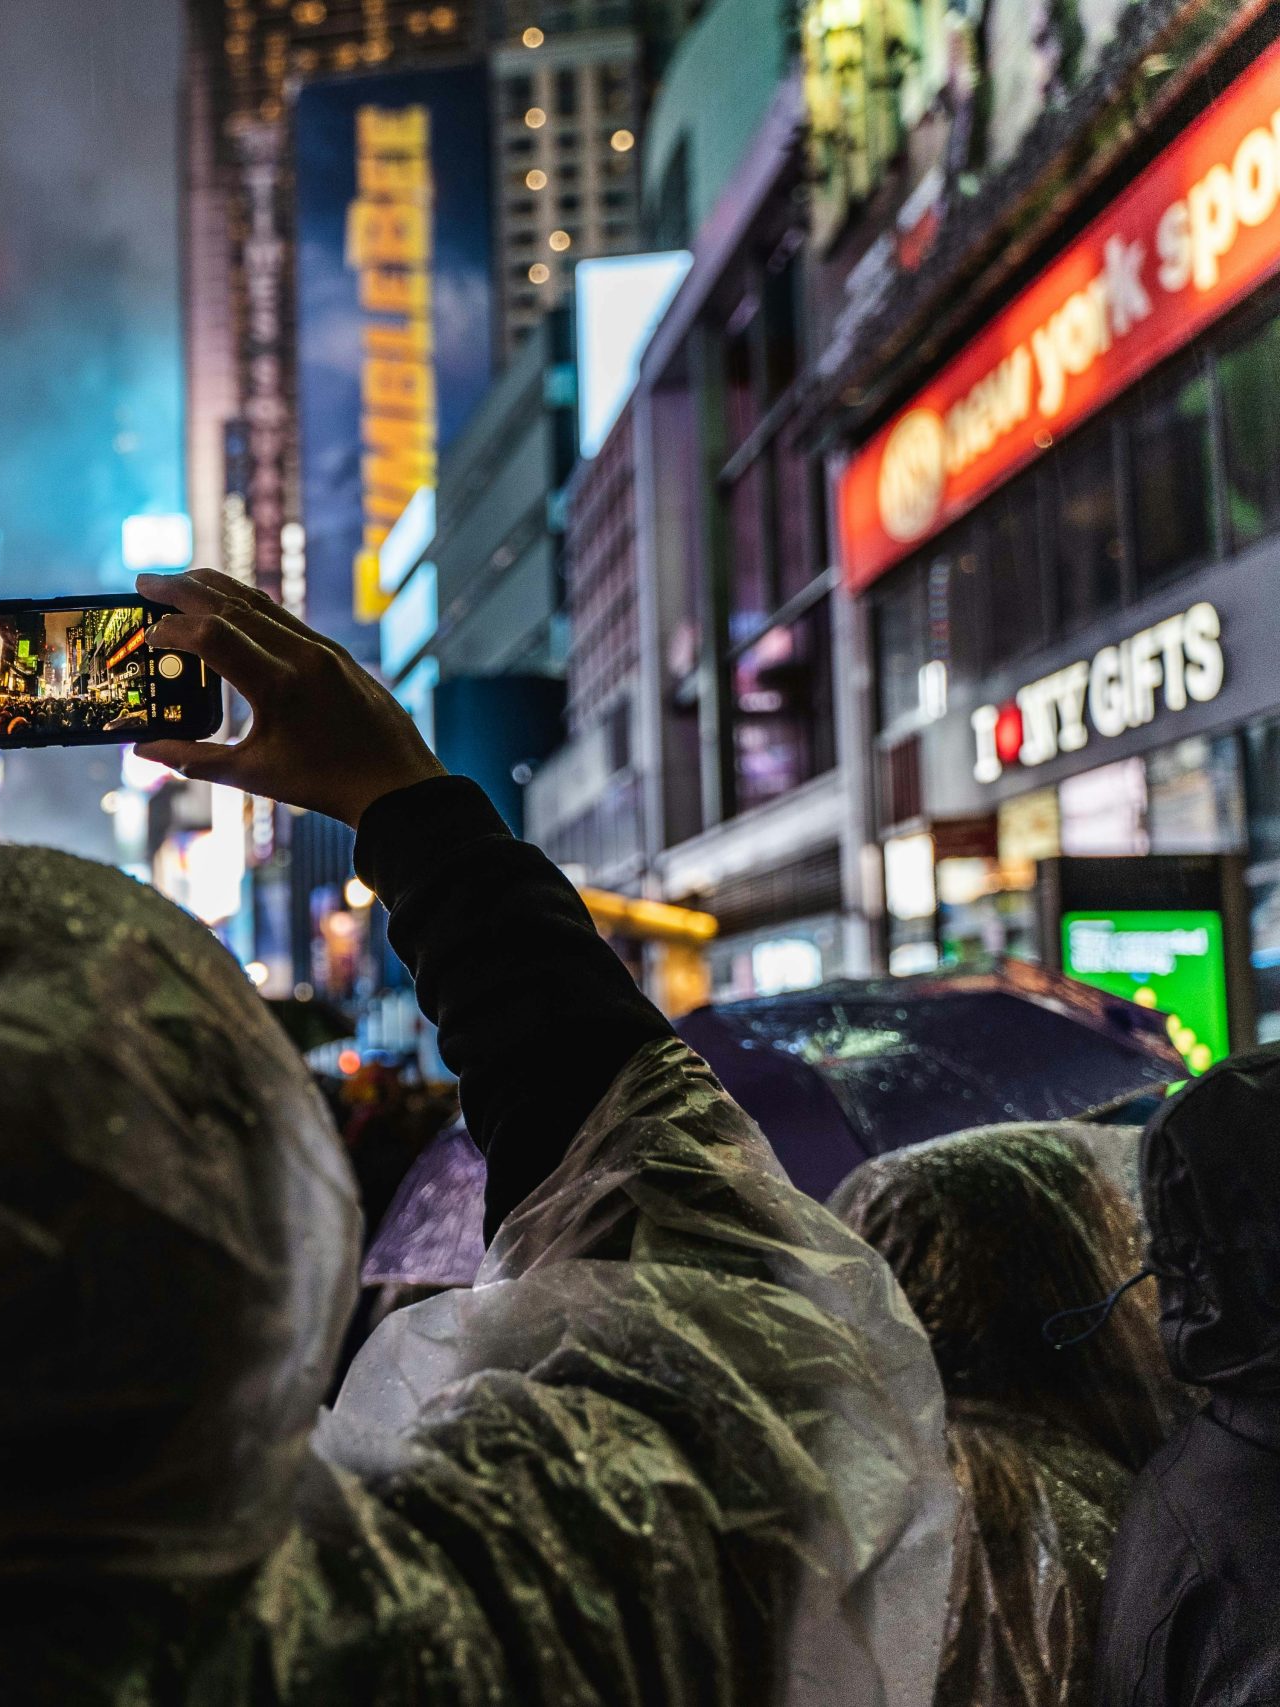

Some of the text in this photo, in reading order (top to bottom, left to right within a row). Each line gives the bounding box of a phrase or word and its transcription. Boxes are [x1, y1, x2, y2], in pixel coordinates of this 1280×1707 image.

[942, 106, 1280, 478] new york spo
[1016, 660, 1088, 767] NY
[1088, 601, 1224, 738] GIFTS
